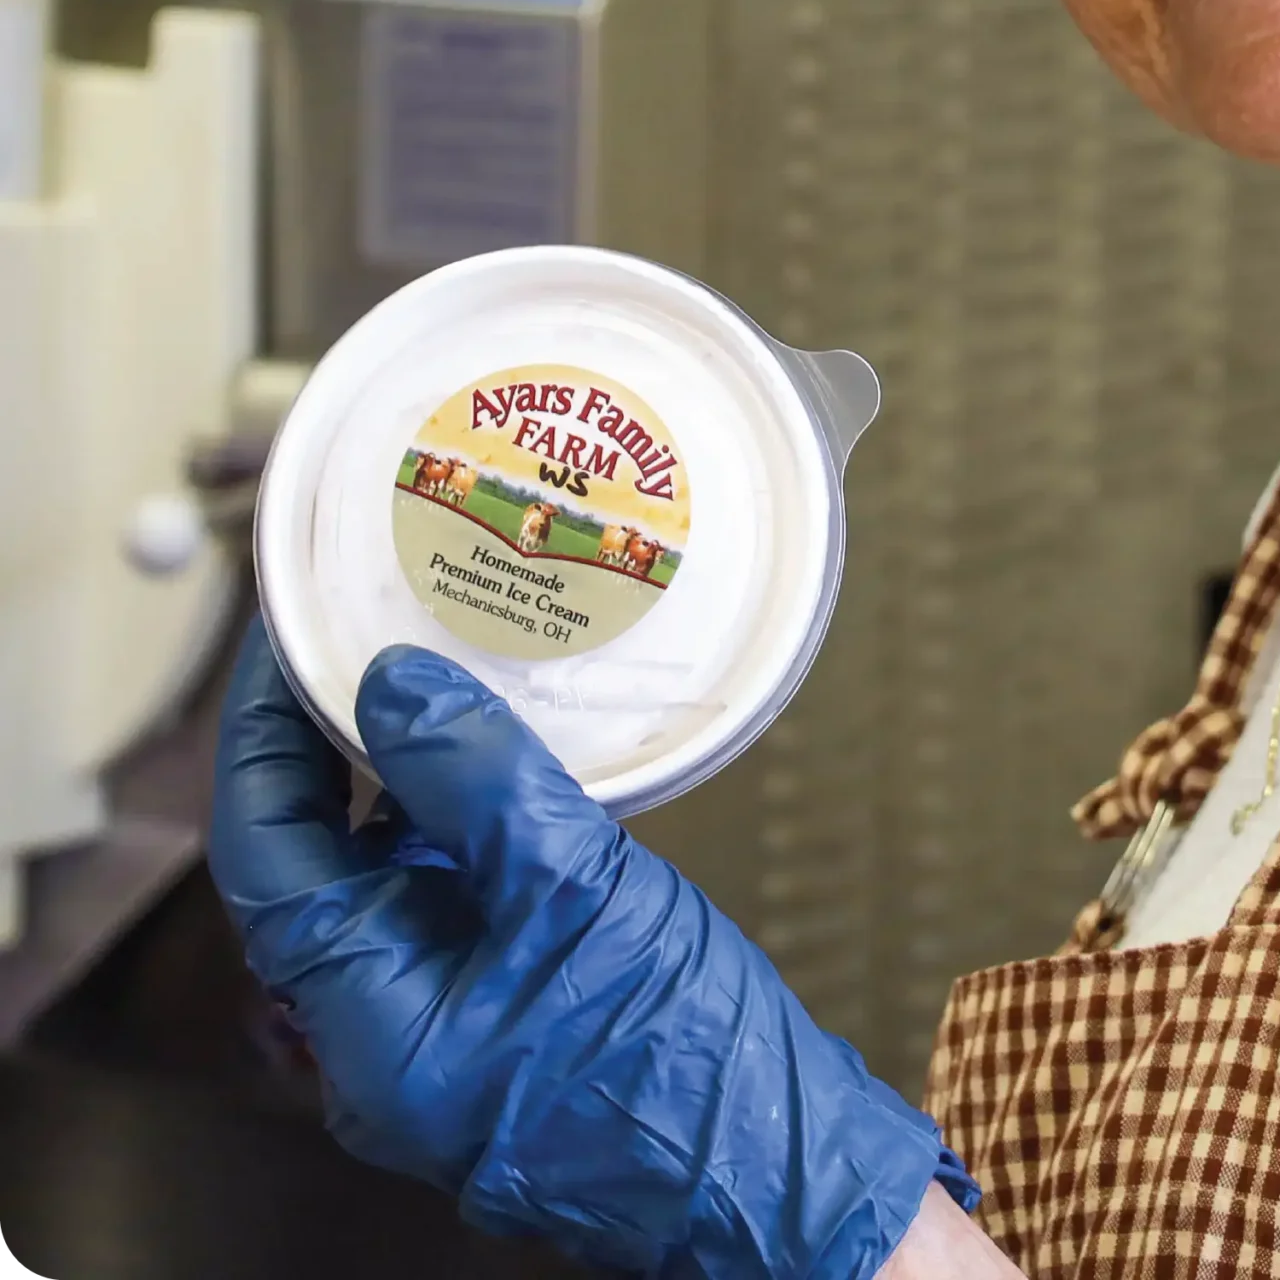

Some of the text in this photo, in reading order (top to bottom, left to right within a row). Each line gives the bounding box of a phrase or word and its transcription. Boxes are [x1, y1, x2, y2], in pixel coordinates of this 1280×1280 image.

[471, 382, 679, 502] Ayars Family
[512, 416, 621, 481] FARM
[429, 553, 590, 628] Premium Ice Cream
[470, 545, 565, 593] Homemade
[432, 580, 572, 644] Mechanicsburg, OH
